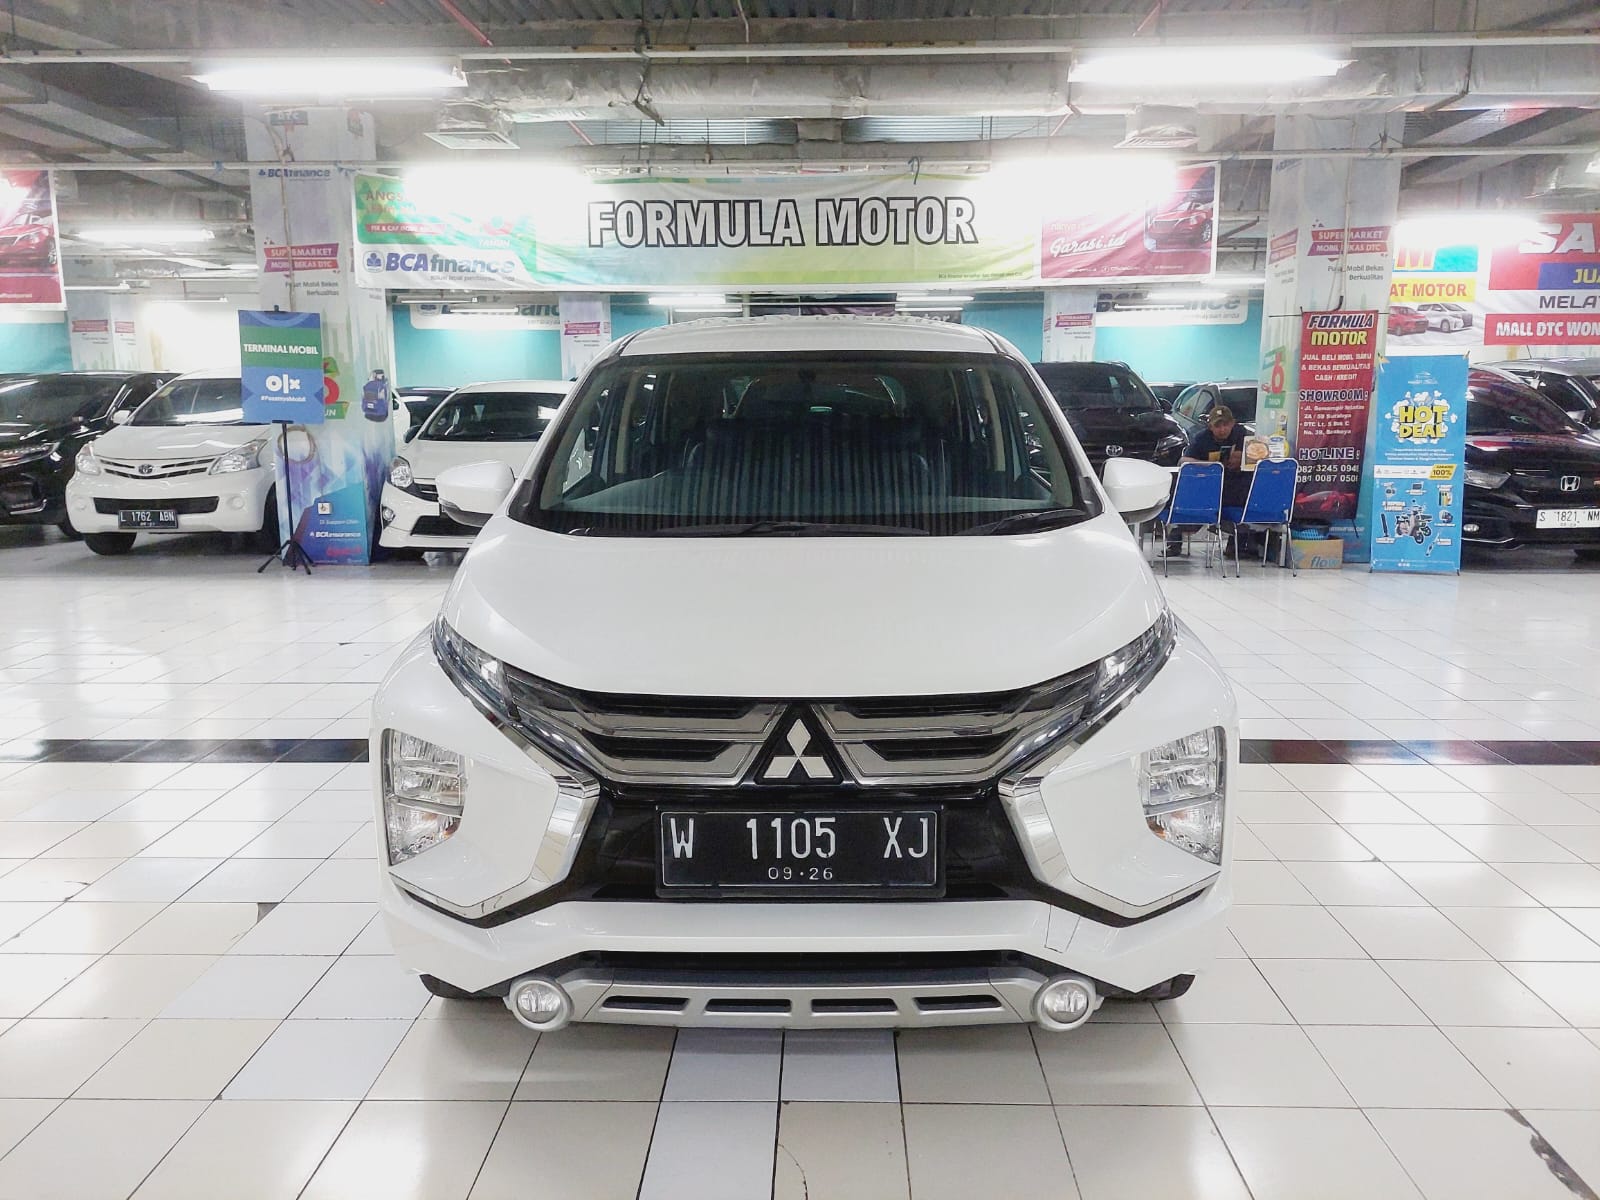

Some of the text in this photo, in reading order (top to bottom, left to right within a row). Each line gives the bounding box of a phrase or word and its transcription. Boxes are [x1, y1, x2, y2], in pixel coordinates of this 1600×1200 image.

[588, 196, 979, 248] FORMULA MOTOR
[1412, 283, 1467, 297] MOTOR
[1307, 314, 1374, 330] FORMULA
[1496, 322, 1534, 336] MALL
[1536, 321, 1564, 337] DTC
[1311, 331, 1367, 346] MOTOR
[243, 344, 319, 355] TERMINAL MOBIL
[1399, 405, 1449, 424] HOT
[1399, 424, 1446, 439] DEAL
[1298, 447, 1355, 461] HOTLINE
[1316, 464, 1338, 472] 3245
[1315, 474, 1338, 482] 0087
[120, 511, 175, 522] L 1762 ABN
[1539, 511, 1546, 522] S
[670, 817, 930, 860] W 1105 XJ
